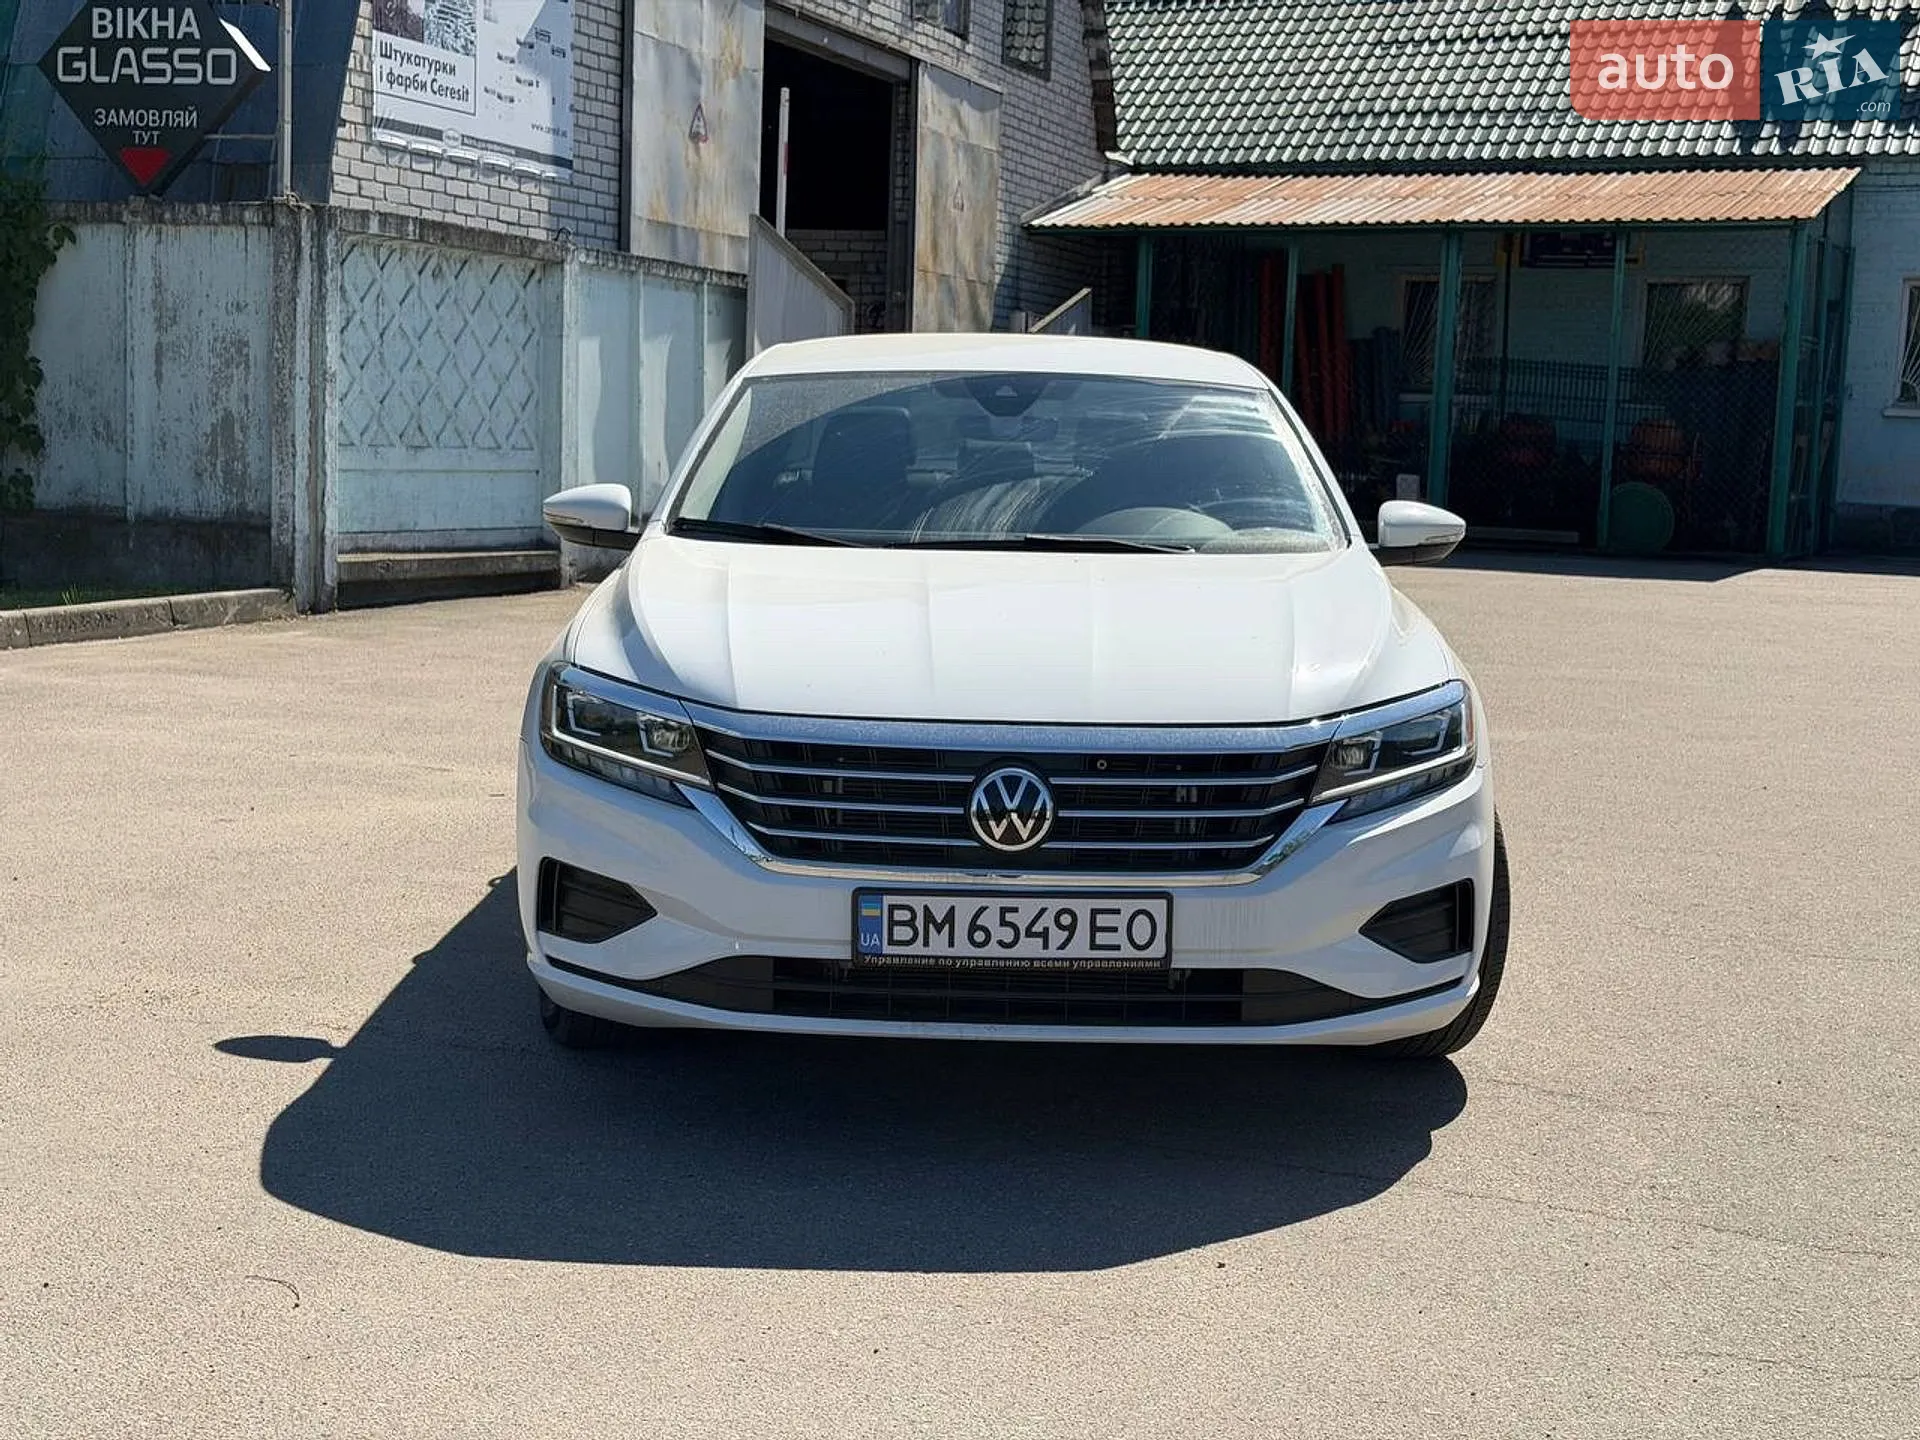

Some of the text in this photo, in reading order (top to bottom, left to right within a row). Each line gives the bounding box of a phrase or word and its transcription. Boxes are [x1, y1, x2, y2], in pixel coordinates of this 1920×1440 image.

[92, 8, 200, 39] ВІКНА
[57, 46, 237, 85] GLASSO
[379, 41, 457, 77] Штукатурки
[386, 69, 428, 94] фарби
[430, 80, 470, 103] Ceresit
[94, 106, 198, 128] ЗАМОВЛЯЙ
[133, 130, 161, 145] ТУТ
[861, 933, 881, 947] UA
